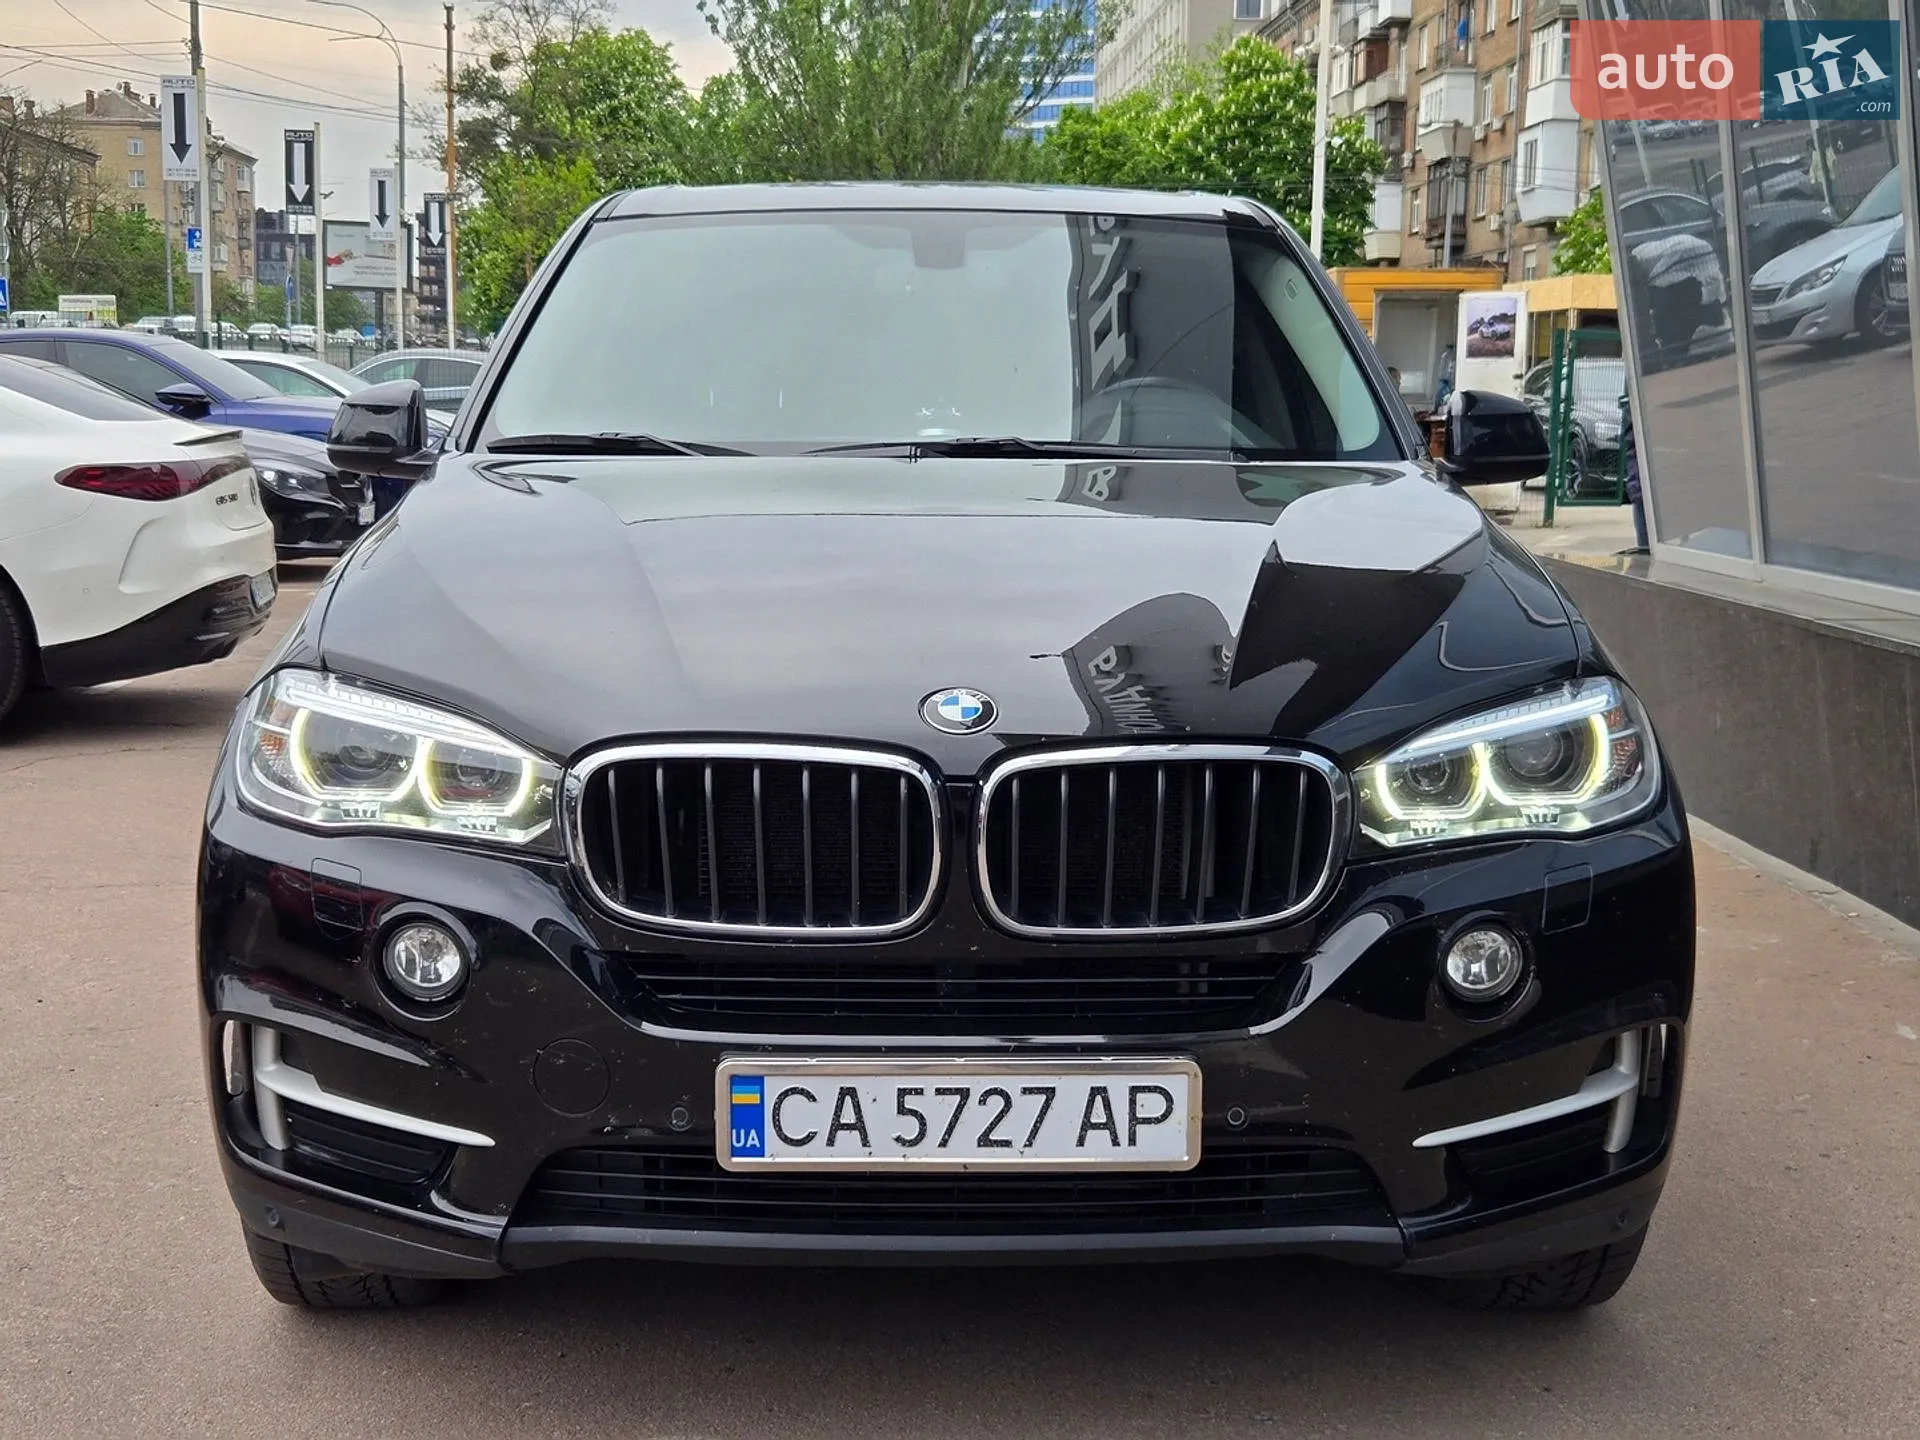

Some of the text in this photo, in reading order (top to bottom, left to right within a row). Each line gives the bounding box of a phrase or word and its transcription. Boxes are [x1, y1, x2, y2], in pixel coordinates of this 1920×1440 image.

[771, 1085, 1175, 1148] CA 5727 AP
[732, 1128, 761, 1148] UA
